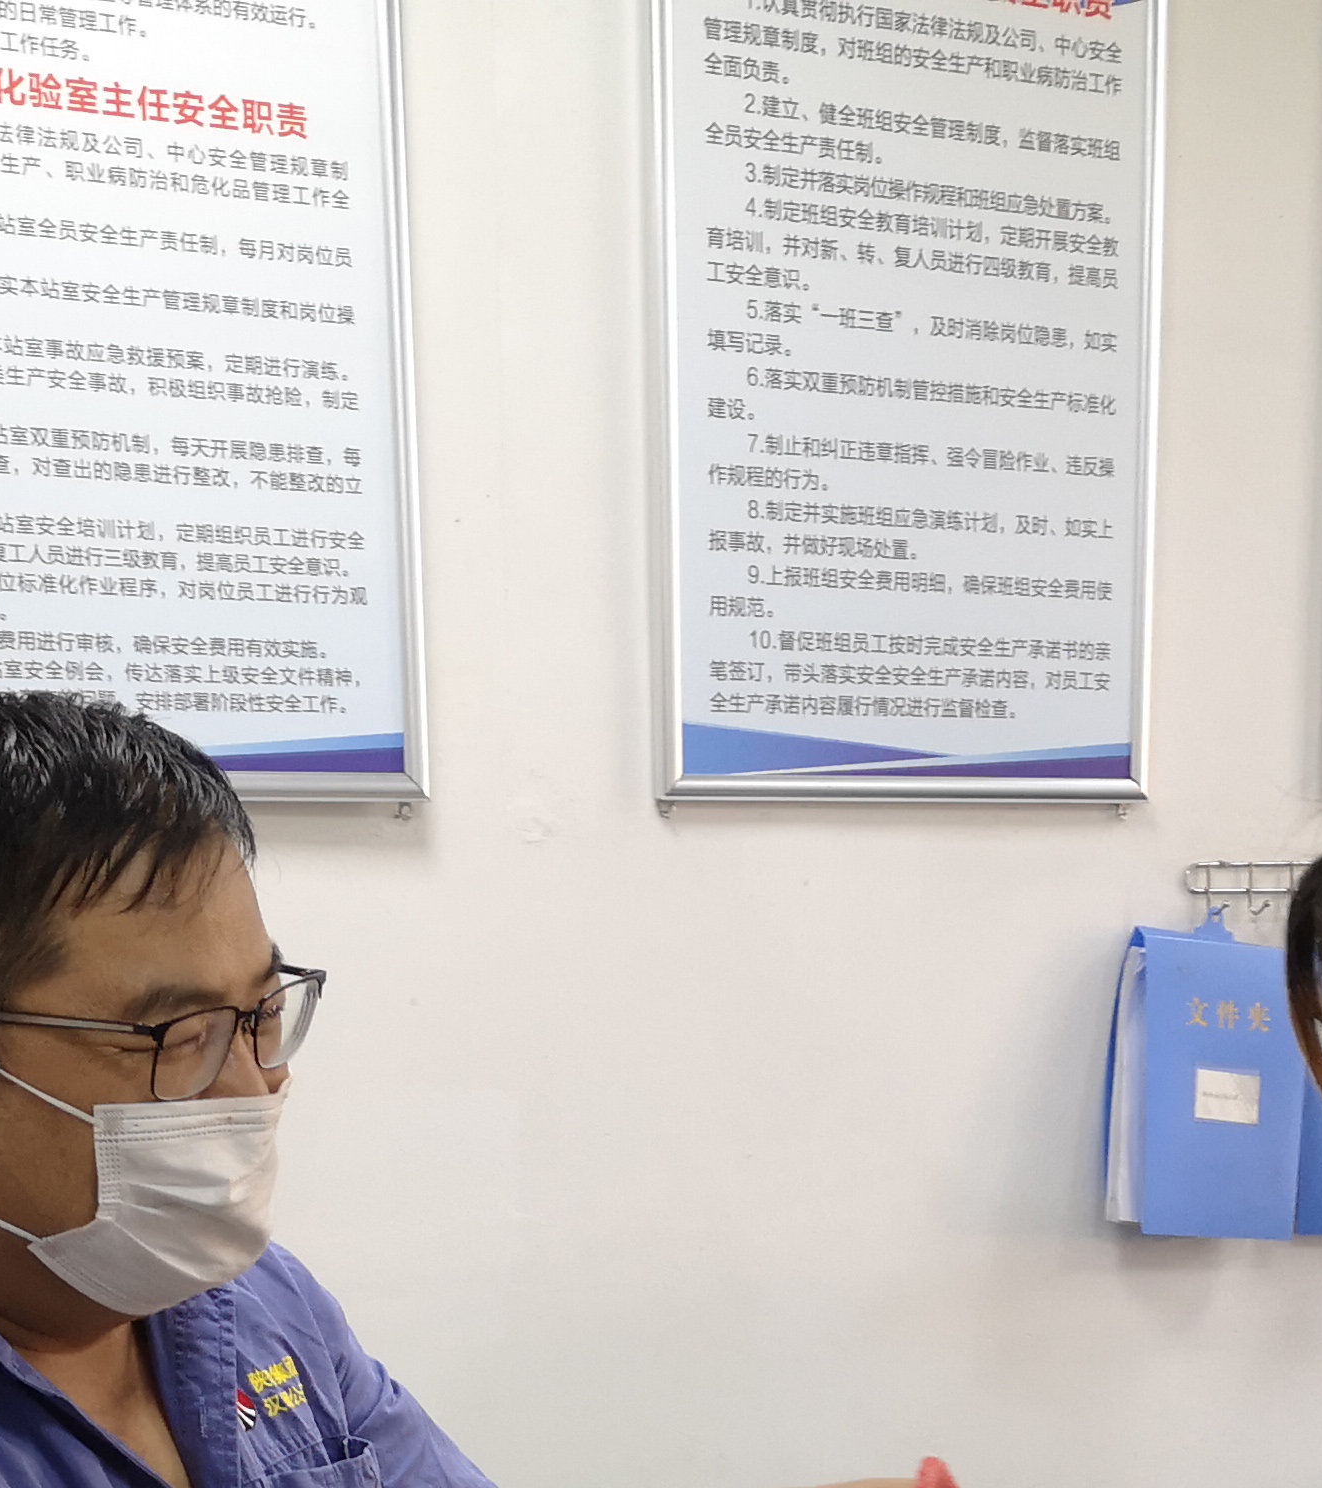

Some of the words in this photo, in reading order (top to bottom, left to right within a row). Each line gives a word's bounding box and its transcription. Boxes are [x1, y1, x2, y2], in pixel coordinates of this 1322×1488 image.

[704, 16, 1122, 95] 管理规章制度，对班组的安全生产和职业病防治工作
[704, 52, 789, 84] 全面负责。
[744, 93, 1120, 160] 2.建立、健全班组安全管理制度，监督落实班组
[705, 122, 882, 164] 全员安全生产责任制。
[745, 162, 1111, 224] 3.制定并落实岗位操作规程和班组应急处置方案。
[745, 197, 1119, 257] 4.制定班组安全教育培训计划，定期开展安全教
[707, 262, 810, 291] 工安全意识。
[707, 328, 792, 356] 填写记录。
[746, 366, 1116, 415] 6.落实双重预防机制管控措施和安全生产标准化
[707, 397, 755, 420] 建设。
[708, 463, 829, 491] 作规程的行为。
[708, 528, 917, 560] 报事故，并做好现场处置。
[709, 595, 774, 618] 用规范。
[749, 629, 1111, 661] 10.督促班组员工按时完成安全生产承诺书的亲
[709, 691, 1015, 719] 全生产承诺内容履行情况进行监督检查。
[1186, 997, 1271, 1032] 文件夹
